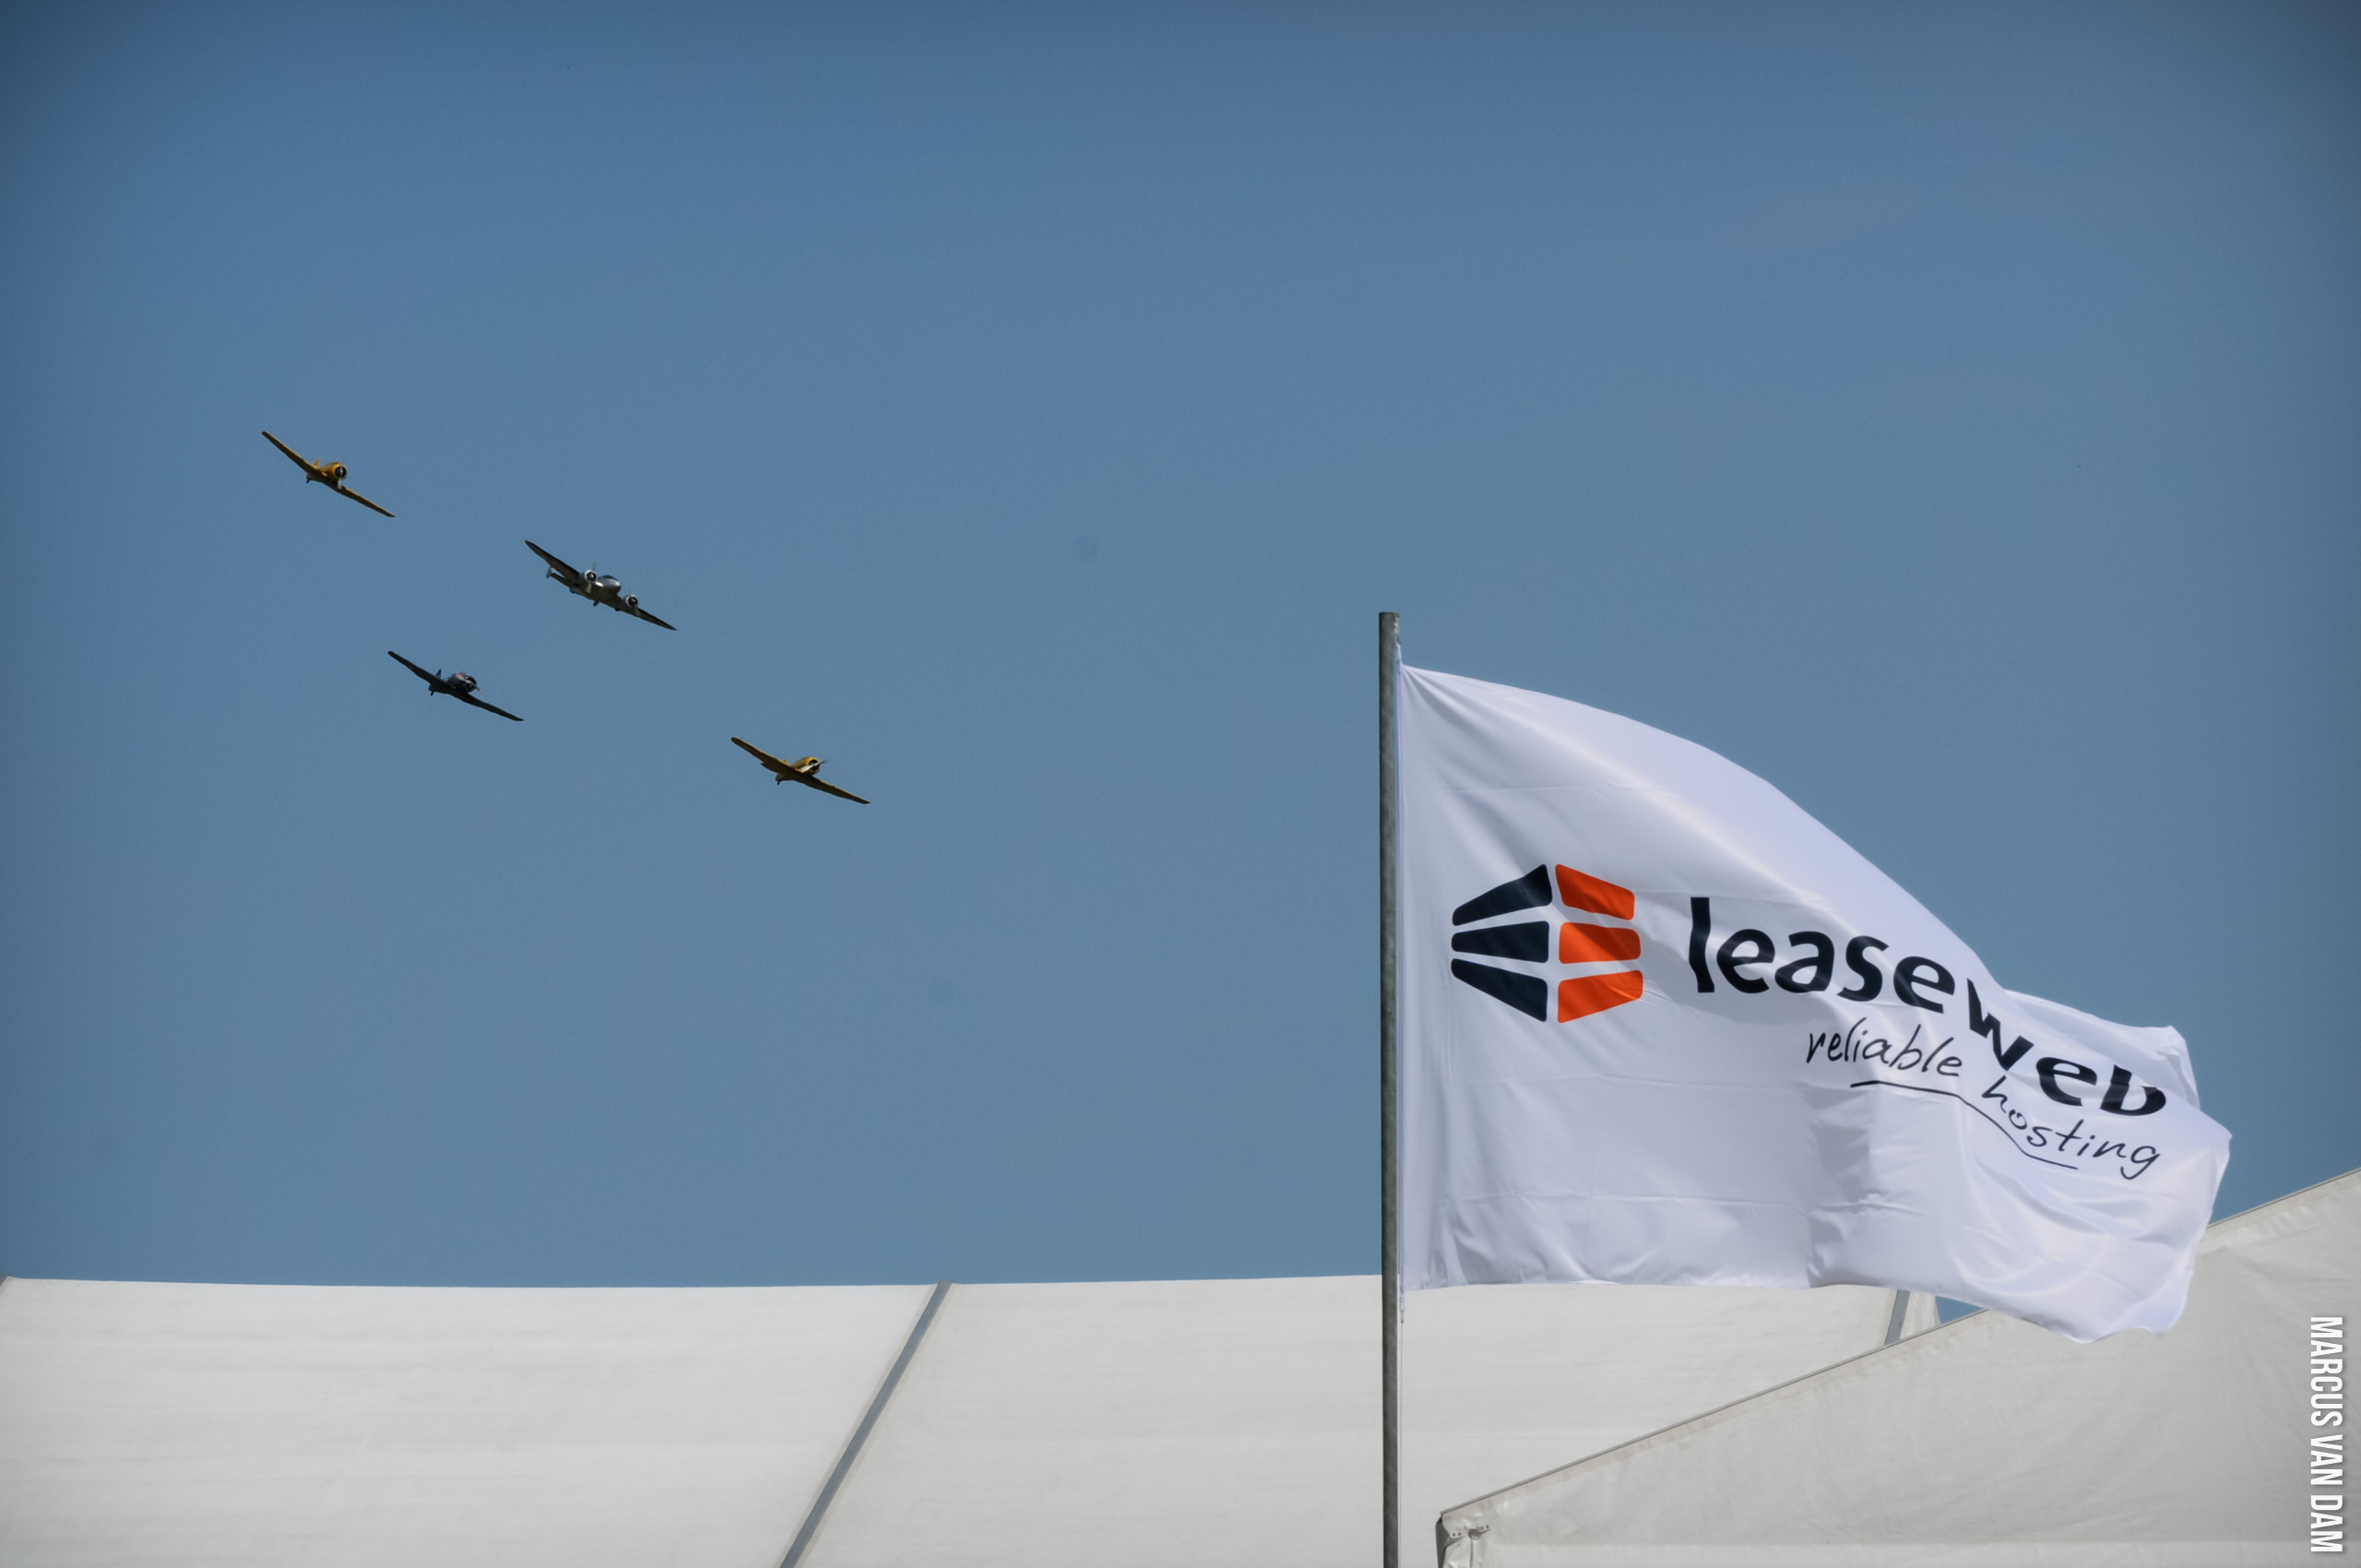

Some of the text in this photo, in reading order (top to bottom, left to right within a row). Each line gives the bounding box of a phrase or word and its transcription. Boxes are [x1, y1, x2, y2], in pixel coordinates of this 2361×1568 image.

[1688, 896, 2166, 1117] leaseweb
[1806, 1016, 2161, 1181] reliable hosting
